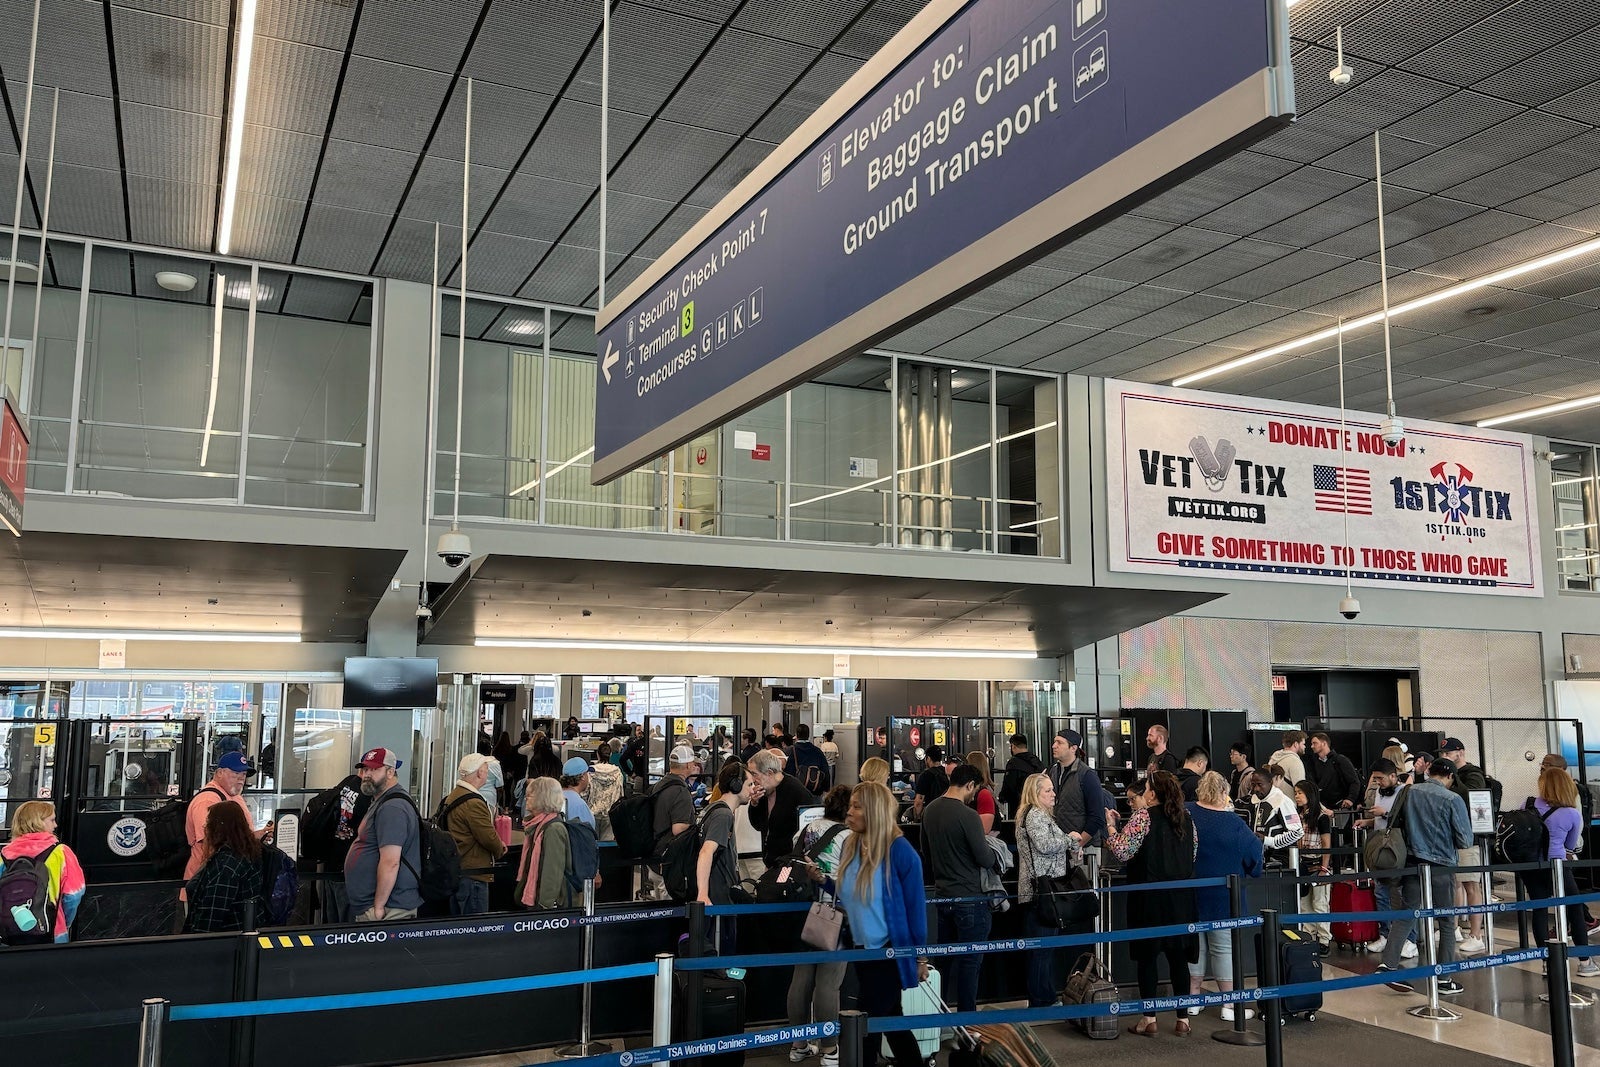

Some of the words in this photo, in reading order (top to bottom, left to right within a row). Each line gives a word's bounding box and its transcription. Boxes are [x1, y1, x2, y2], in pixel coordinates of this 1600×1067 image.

[841, 77, 925, 168] Elevator
[932, 44, 964, 89] to:
[867, 97, 966, 192] Baggage
[975, 24, 1057, 105] Claim
[843, 177, 918, 255] Ground
[925, 77, 1058, 197] Transport
[639, 288, 679, 333] Security
[682, 254, 718, 297] Check
[721, 220, 756, 267] Point
[759, 208, 768, 235] 7
[637, 344, 697, 397] Concourses
[702, 329, 711, 353] G
[717, 317, 727, 343] H
[733, 305, 743, 333] K
[751, 296, 760, 321] L
[639, 317, 679, 365] Terminal
[684, 308, 691, 330] 3
[1268, 421, 1352, 451] DONATE
[1139, 449, 1194, 489] VET
[1234, 459, 1288, 498] TIX
[1175, 500, 1258, 519] VETTIX.ORG
[1389, 476, 1438, 513] 1ST
[1467, 485, 1512, 521] TIX
[1425, 523, 1486, 538] 1STTIX.ORG
[1157, 532, 1205, 556] GIVE
[1212, 536, 1325, 565] SOMETHING
[1331, 545, 1354, 567] TO
[1360, 547, 1417, 571] THOSE
[1421, 552, 1463, 574] WHO
[1467, 555, 1508, 577] GAVE
[909, 705, 936, 717] LANE
[939, 705, 944, 716] 1
[38, 727, 51, 744] 5
[676, 720, 684, 733] 4
[936, 731, 943, 744] 3
[1007, 721, 1014, 733] 2
[1124, 722, 1129, 733] 1
[514, 917, 569, 933] CHICAGO
[579, 916, 602, 925] O'HARE
[603, 912, 648, 923] INTERNATIONAL
[649, 909, 674, 918] AIRPORT
[325, 931, 387, 945] CHICAGO
[398, 931, 424, 939] O'HARE
[425, 926, 477, 937] INTERNATIONAL
[477, 924, 505, 933] AIRPORT
[916, 947, 927, 955] TSA
[927, 946, 948, 956] Working
[948, 945, 968, 953] Canines
[972, 943, 988, 951] Please
[988, 942, 996, 950] Do
[1459, 962, 1469, 970] TSA
[1469, 960, 1486, 970] Working
[1506, 954, 1520, 963] Please
[1520, 953, 1527, 961] Do
[1143, 1000, 1154, 1010] TSA
[1155, 999, 1178, 1010] Working
[1178, 997, 1200, 1007] Canines
[1204, 994, 1222, 1004] Please
[1222, 993, 1231, 1001] Do
[1231, 992, 1240, 1000] Not
[1241, 991, 1250, 999] Pet
[667, 1046, 683, 1058] TSA
[684, 1042, 716, 1056] Working
[717, 1037, 747, 1051] Canines
[754, 1032, 778, 1045] Please
[779, 1030, 790, 1041] Do
[791, 1028, 804, 1038] Not
[805, 1026, 818, 1036] Pet
